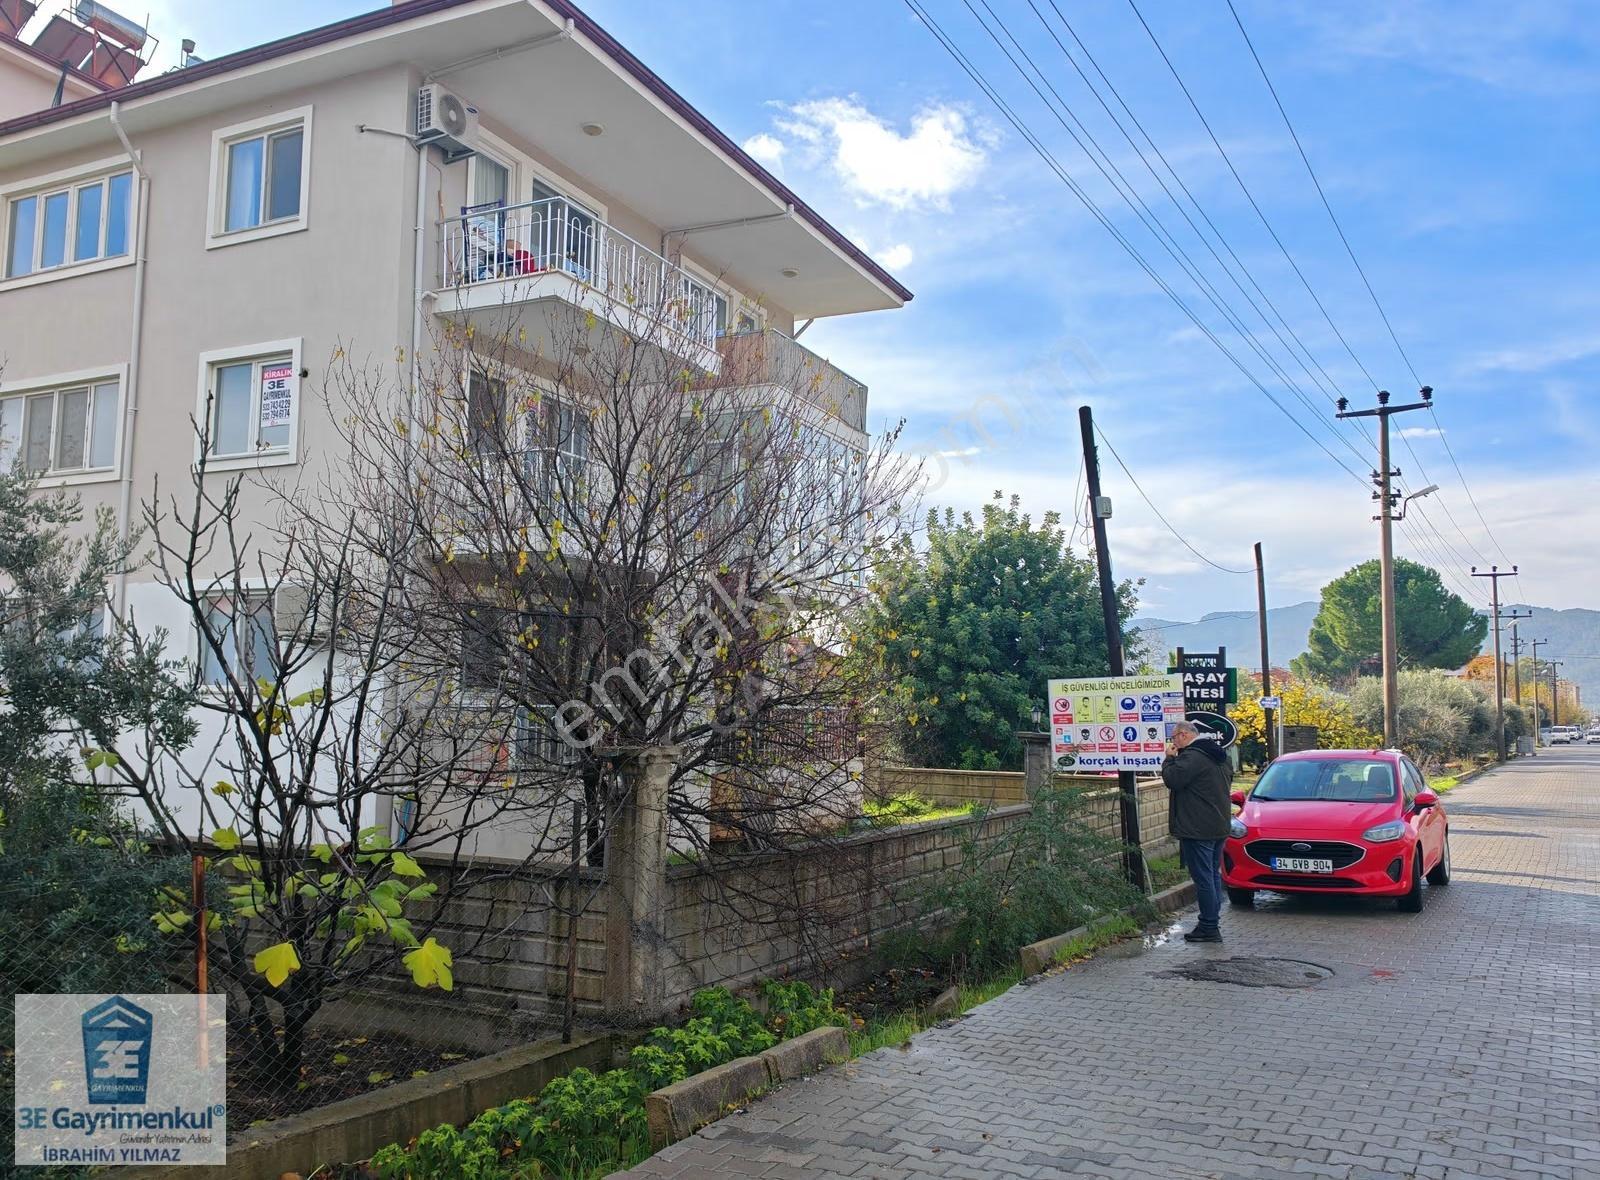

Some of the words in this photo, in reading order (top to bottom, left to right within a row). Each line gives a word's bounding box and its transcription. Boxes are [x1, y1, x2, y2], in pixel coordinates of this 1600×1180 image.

[264, 369, 293, 379] KİRALIK
[268, 379, 285, 390] 3E
[1184, 673, 1227, 685] AŞAY
[1185, 686, 1224, 698] İTESİ
[1079, 756, 1119, 768] korçak
[1123, 756, 1161, 767] inşaat
[1276, 859, 1288, 869] 34
[1292, 860, 1310, 870] GVB
[1313, 860, 1330, 871] 904
